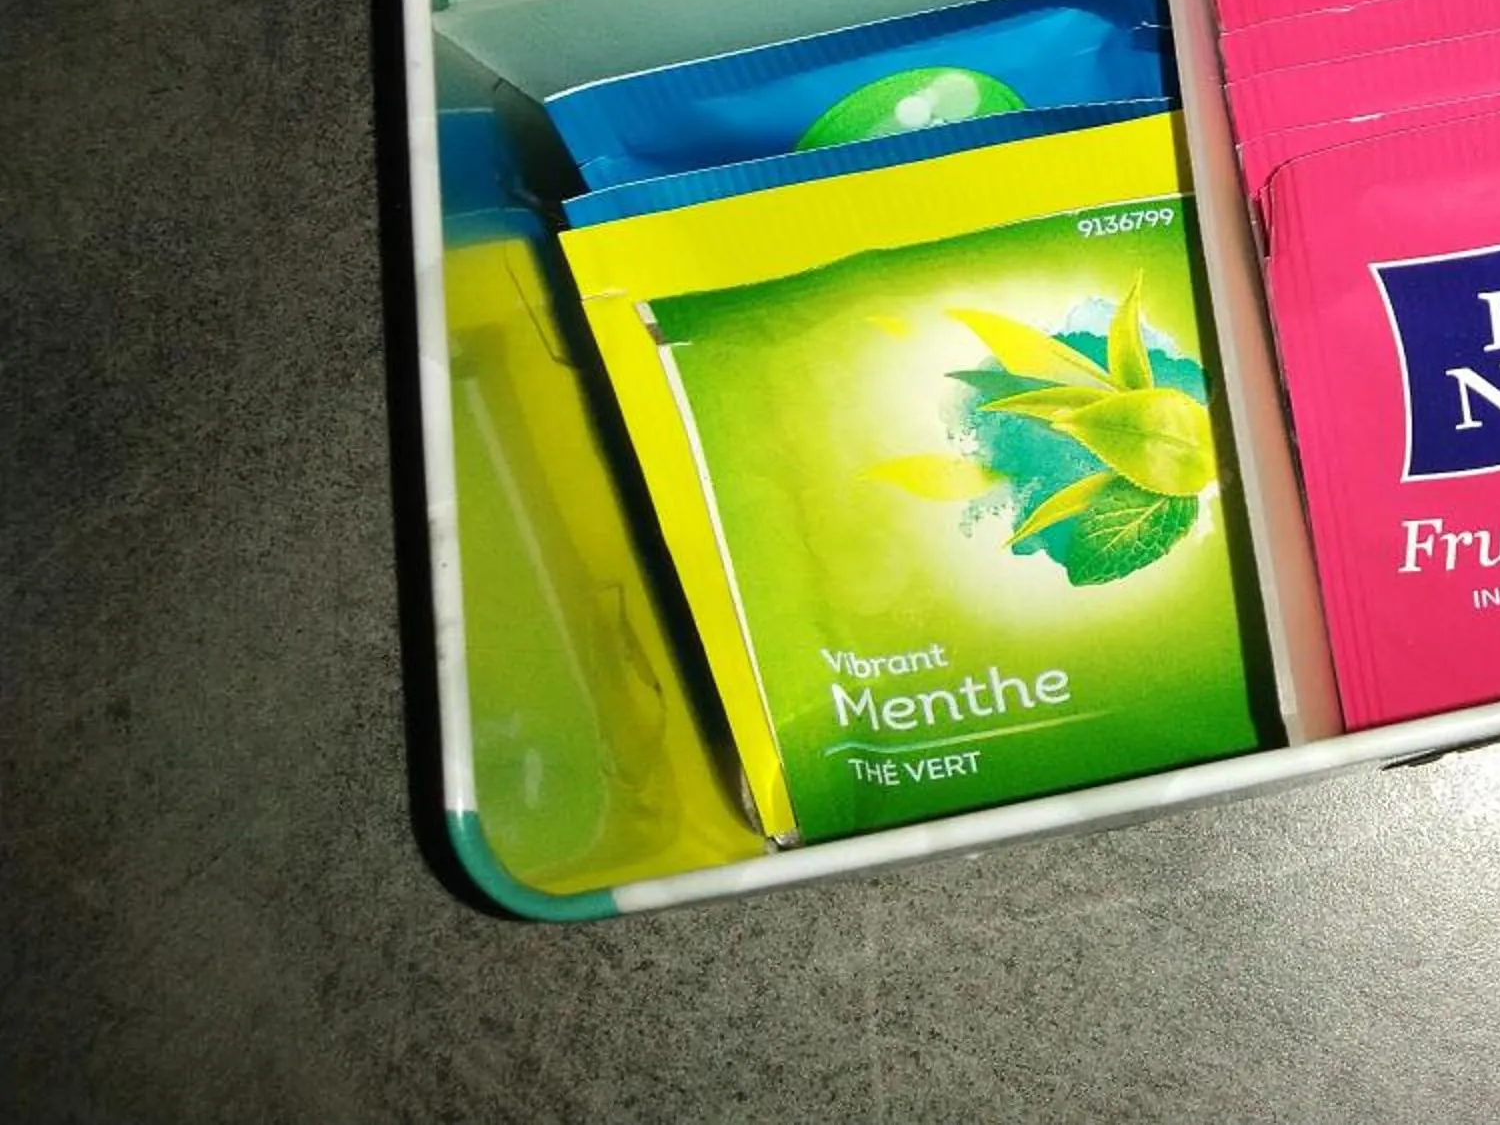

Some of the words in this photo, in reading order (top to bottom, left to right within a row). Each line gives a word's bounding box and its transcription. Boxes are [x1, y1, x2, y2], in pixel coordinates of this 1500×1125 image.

[1077, 208, 1175, 238] 9136799
[820, 643, 949, 679] Vibrant
[831, 666, 1071, 731] Menthe
[848, 757, 900, 786] THÉ
[903, 751, 982, 782] VERT
